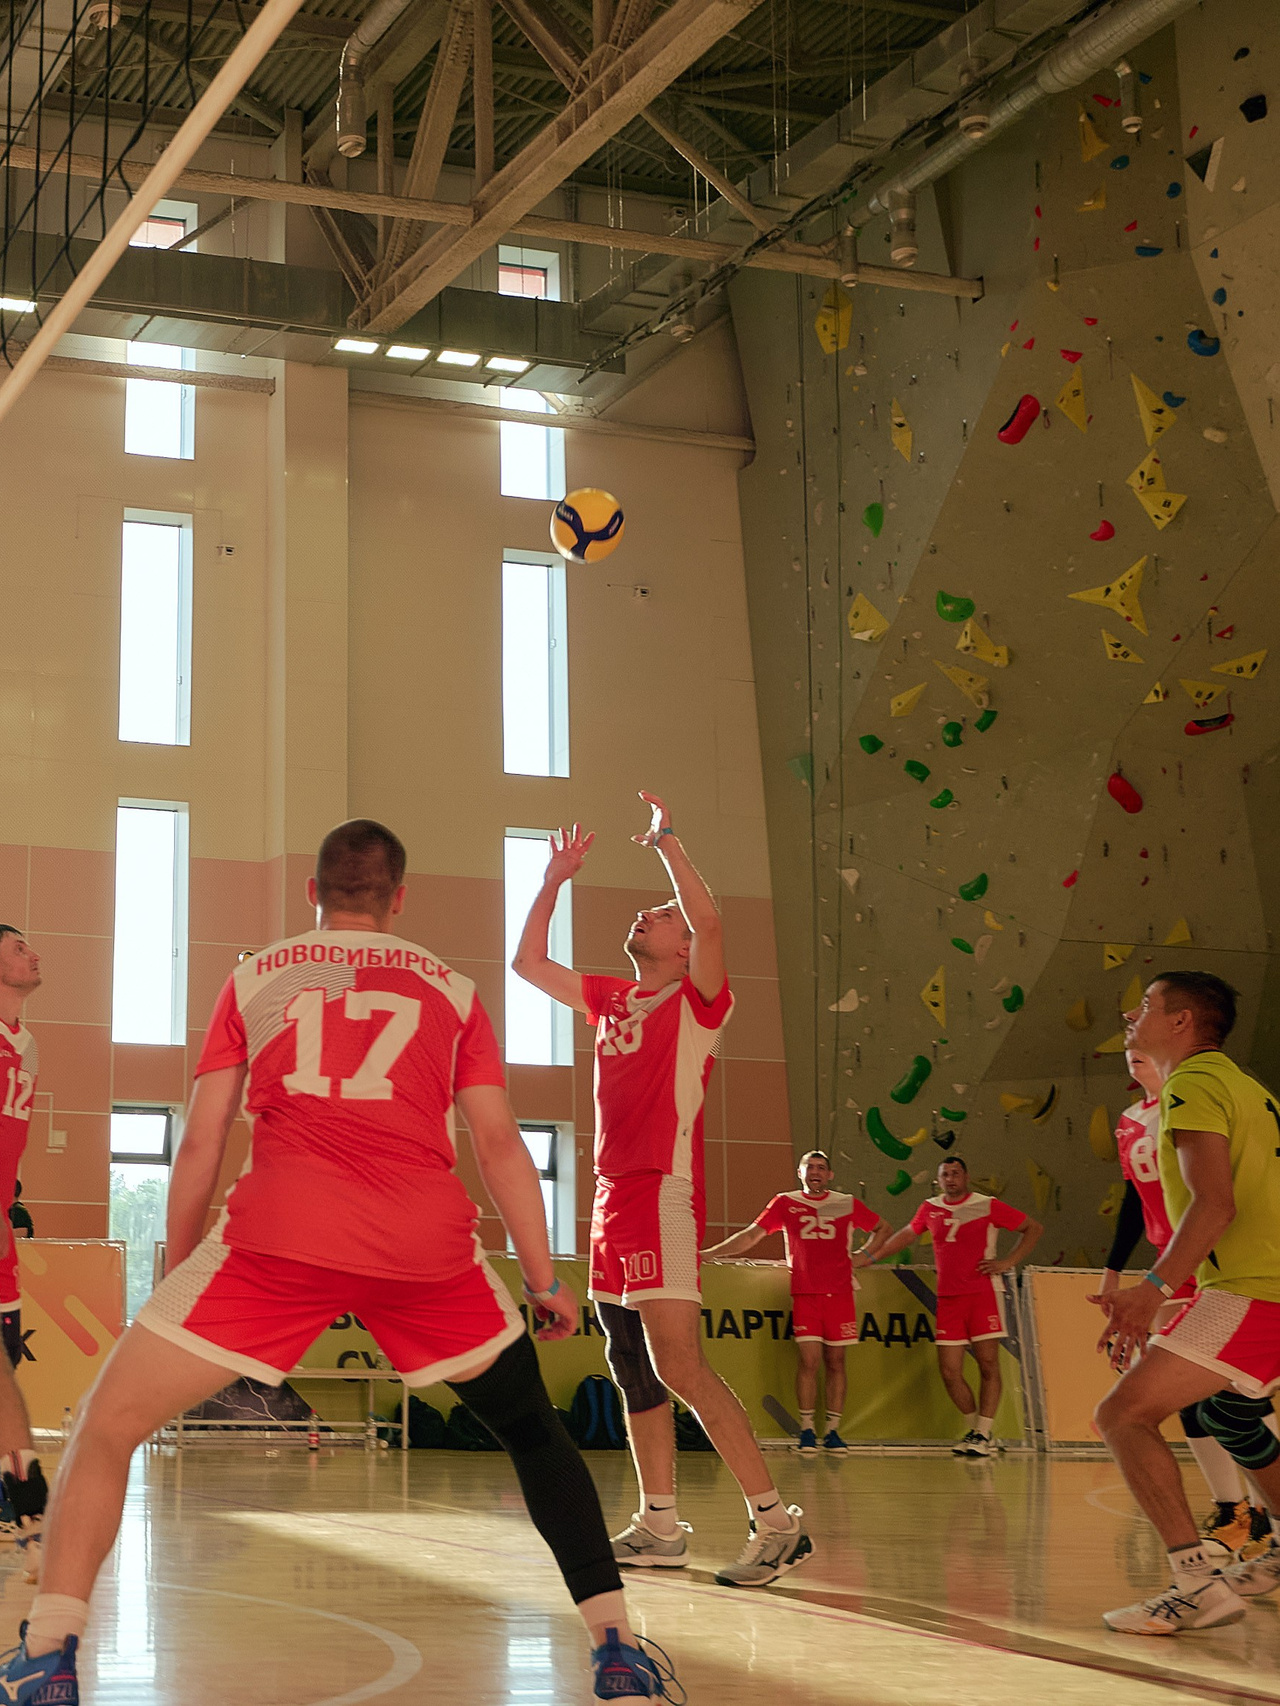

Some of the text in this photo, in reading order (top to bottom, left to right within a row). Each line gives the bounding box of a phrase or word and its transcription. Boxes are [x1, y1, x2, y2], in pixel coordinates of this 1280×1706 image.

[256, 944, 455, 988] НОВОСИБИРСК
[282, 987, 422, 1101] 17
[1, 1066, 34, 1121] 12
[799, 1215, 837, 1240] 25
[943, 1218, 961, 1243] 7
[628, 1250, 658, 1282] 10
